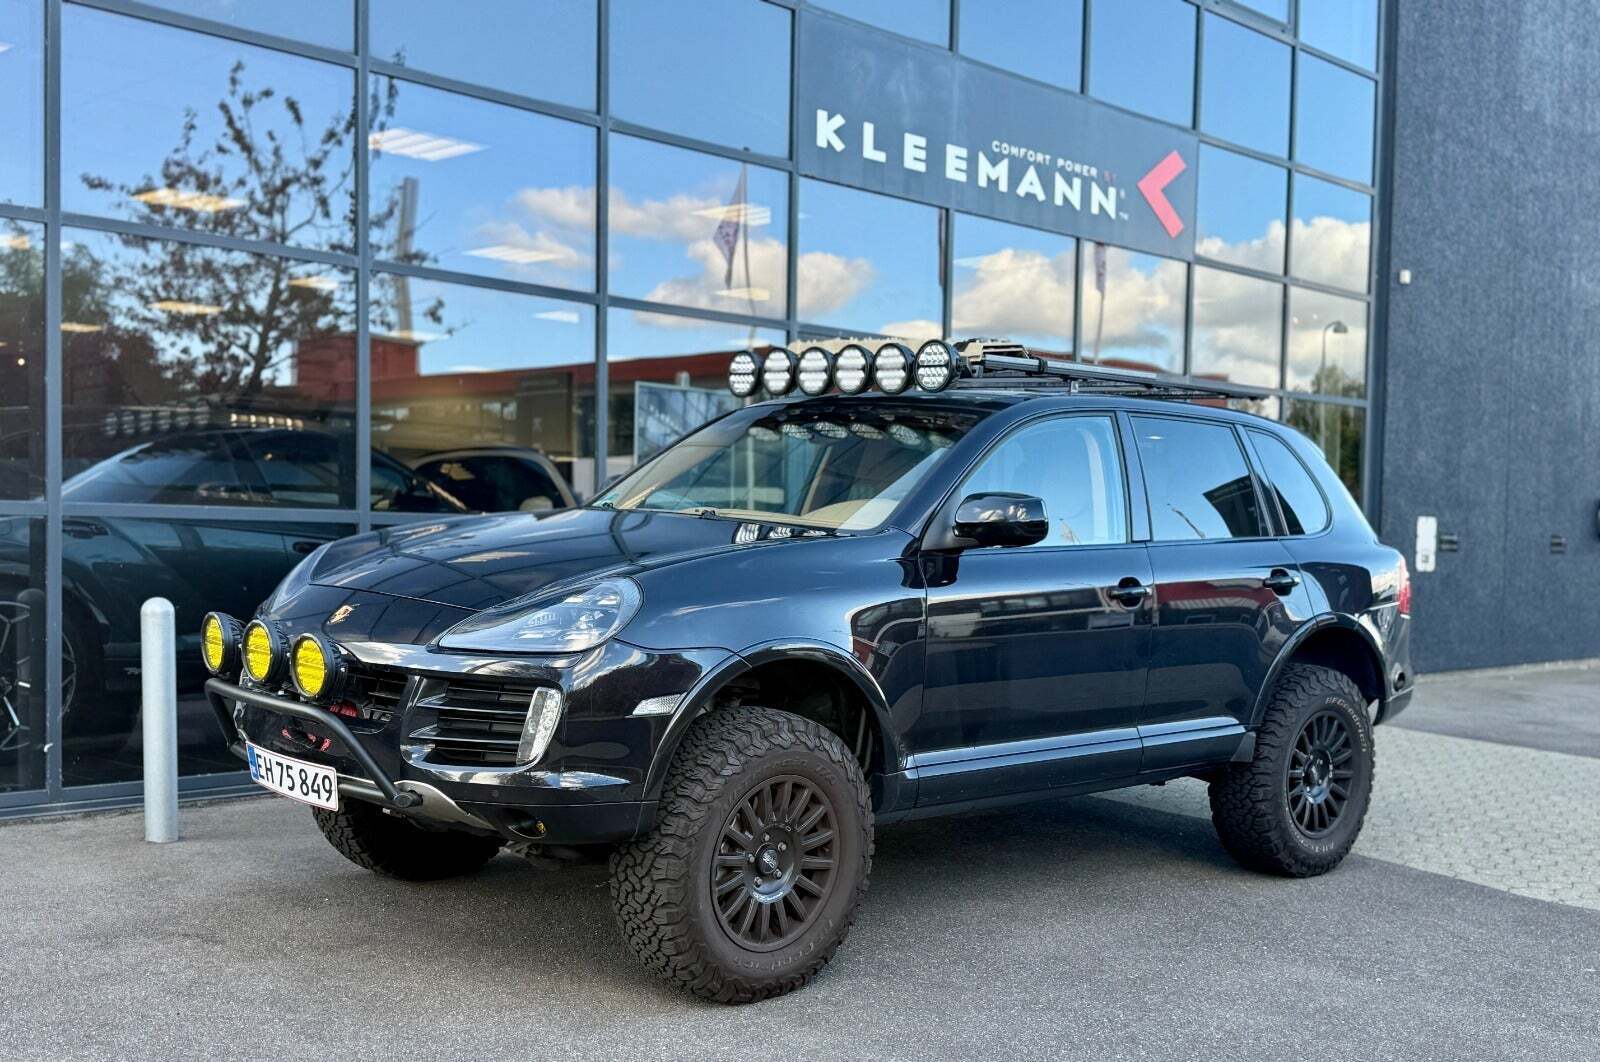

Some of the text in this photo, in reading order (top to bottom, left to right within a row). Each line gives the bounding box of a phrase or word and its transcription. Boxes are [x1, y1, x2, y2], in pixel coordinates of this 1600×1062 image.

[816, 108, 1117, 220] KLEEMANN
[991, 140, 1051, 165] COMFORT
[1057, 157, 1098, 178] POWER
[298, 768, 333, 802] 849
